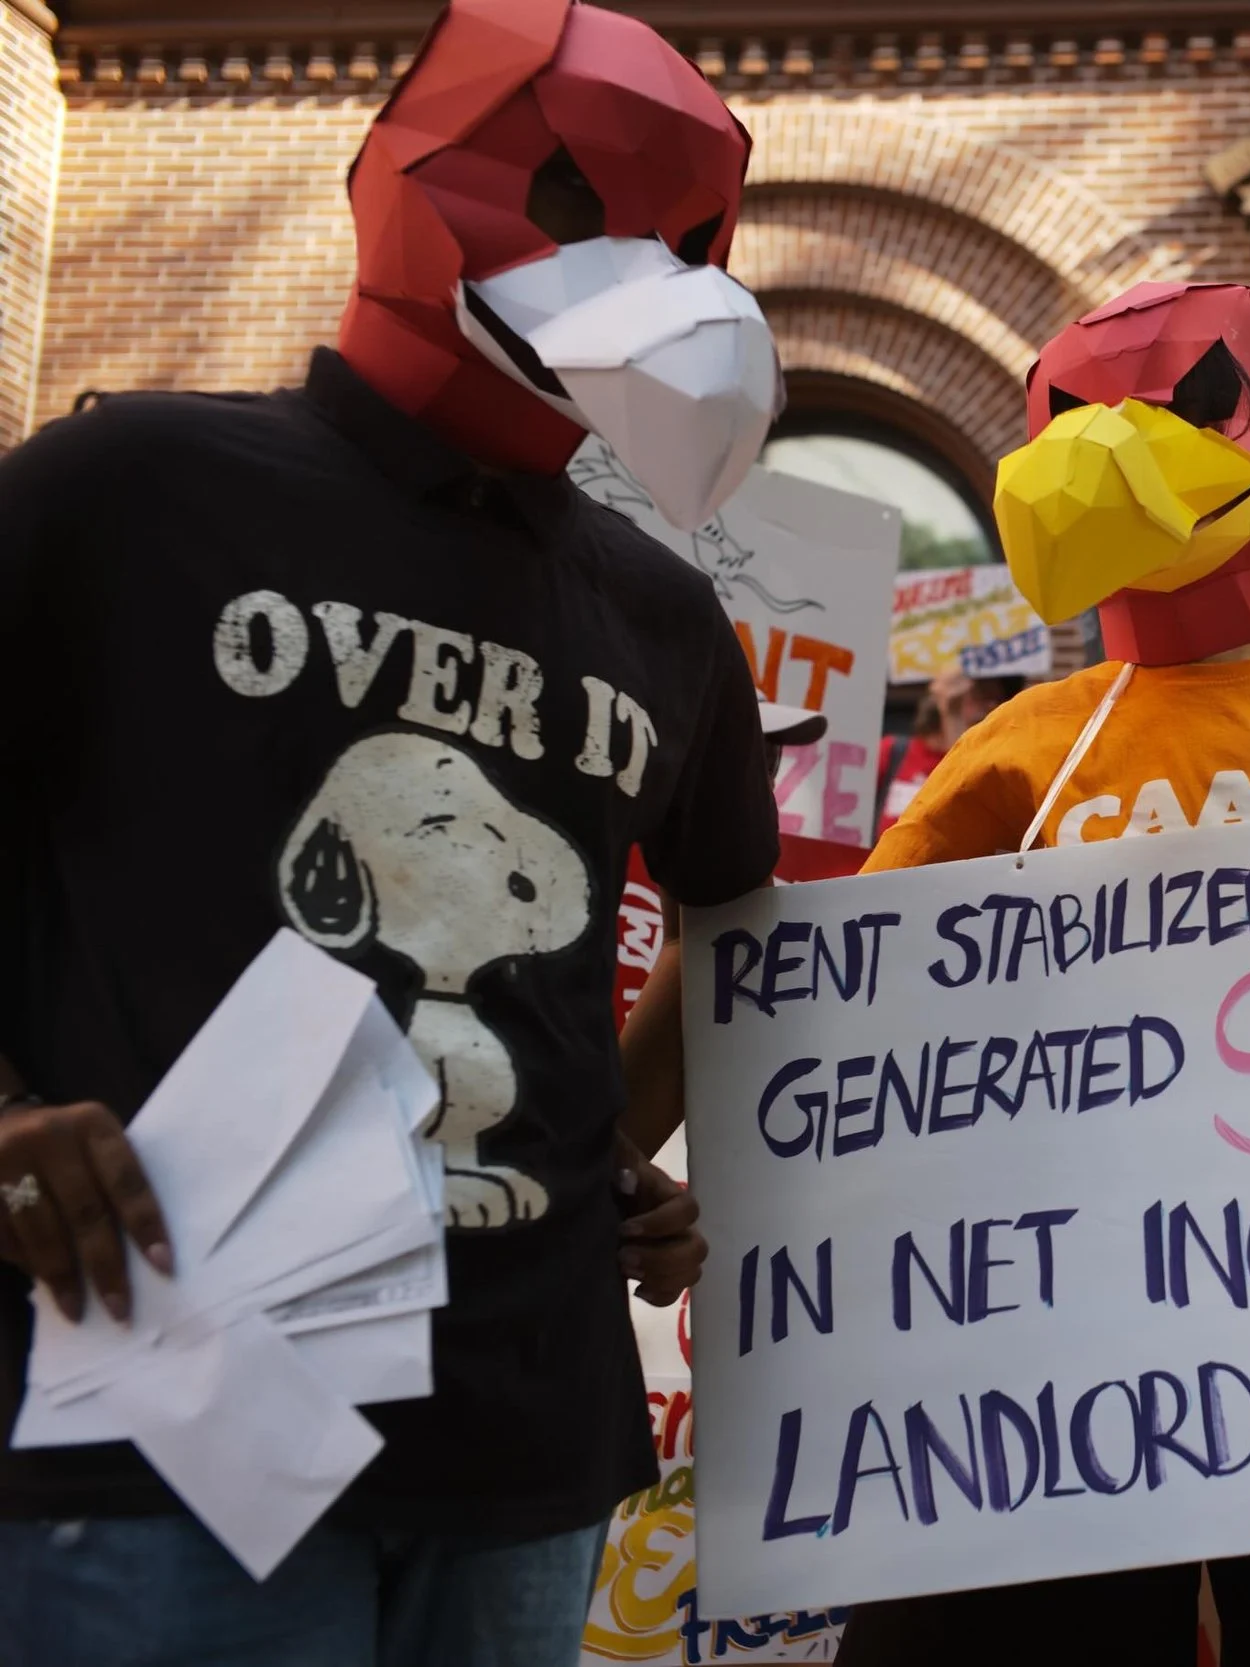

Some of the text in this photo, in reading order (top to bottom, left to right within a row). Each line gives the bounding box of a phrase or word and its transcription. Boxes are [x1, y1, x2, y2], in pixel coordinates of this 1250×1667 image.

[213, 590, 544, 760] OVER
[575, 676, 657, 797] IT
[712, 911, 900, 1024] RENT
[758, 1014, 1185, 1162] GENERATED
[739, 1237, 833, 1357] IN
[892, 1208, 1079, 1331] NET
